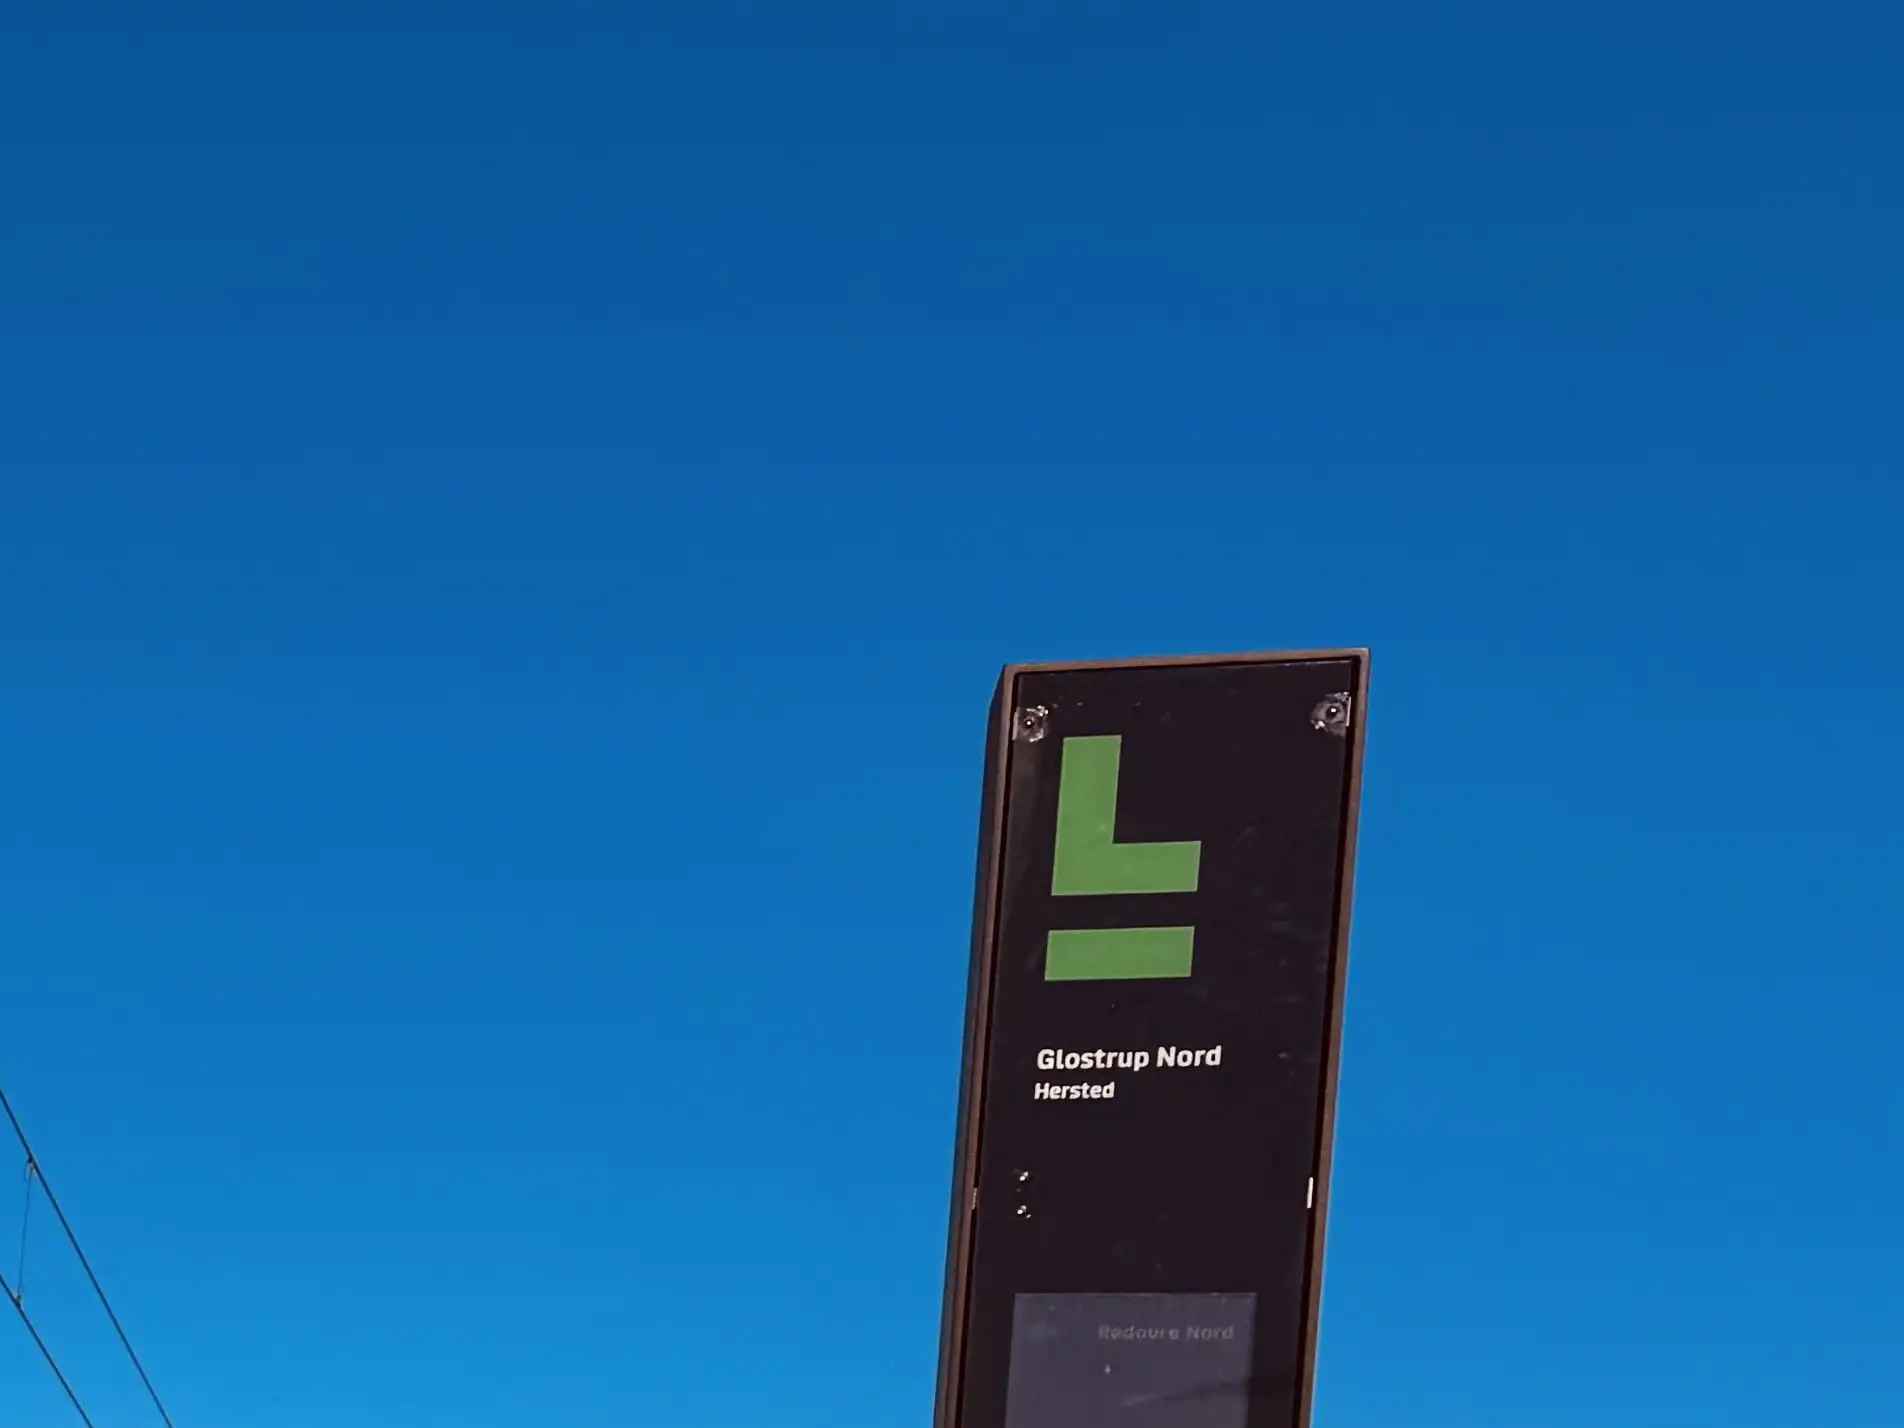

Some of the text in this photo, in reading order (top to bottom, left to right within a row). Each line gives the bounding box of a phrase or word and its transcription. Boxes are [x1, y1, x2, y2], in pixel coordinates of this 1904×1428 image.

[1037, 1045, 1222, 1072] Glostrup Nord
[1034, 1081, 1115, 1100] Hersted
[1186, 1324, 1234, 1340] Nord
